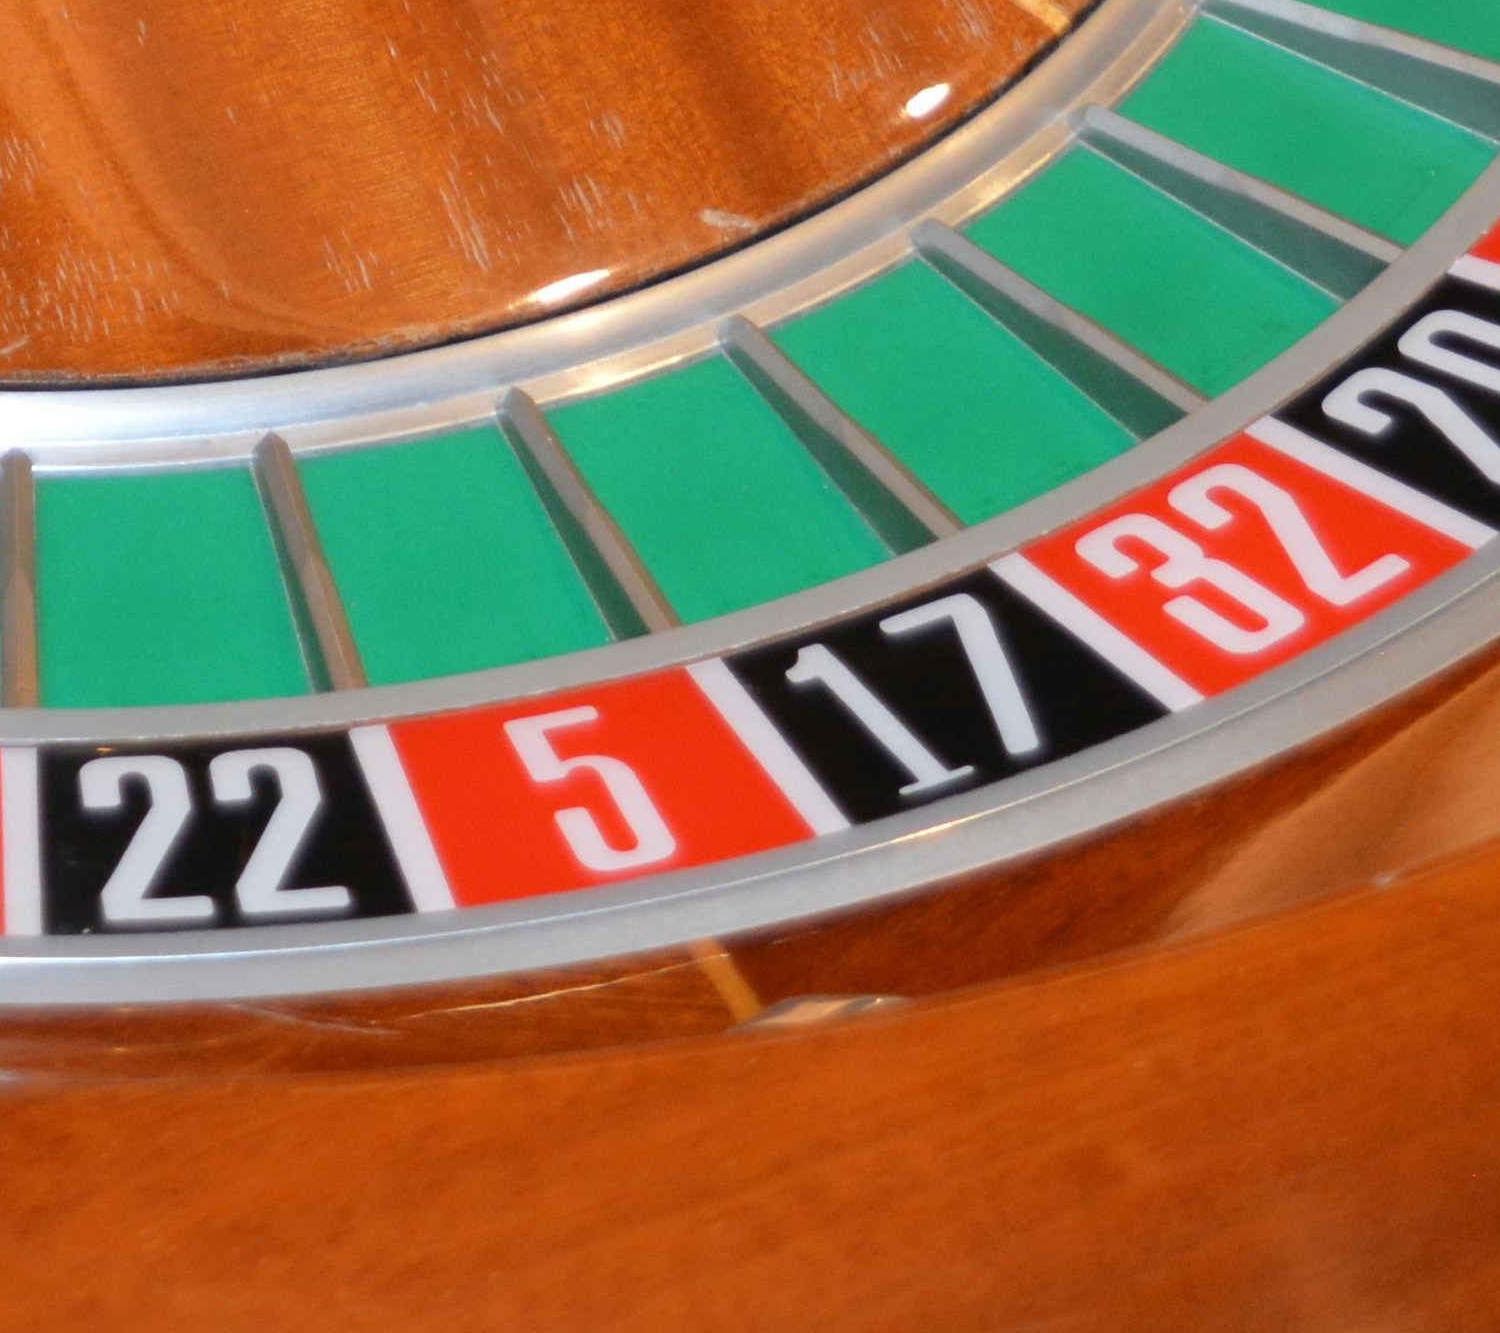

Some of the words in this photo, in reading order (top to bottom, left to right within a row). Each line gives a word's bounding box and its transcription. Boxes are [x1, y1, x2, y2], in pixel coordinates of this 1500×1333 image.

[1073, 462, 1412, 657] 32
[784, 592, 1041, 796] 17
[78, 746, 352, 925] 22
[502, 704, 679, 874] 5
